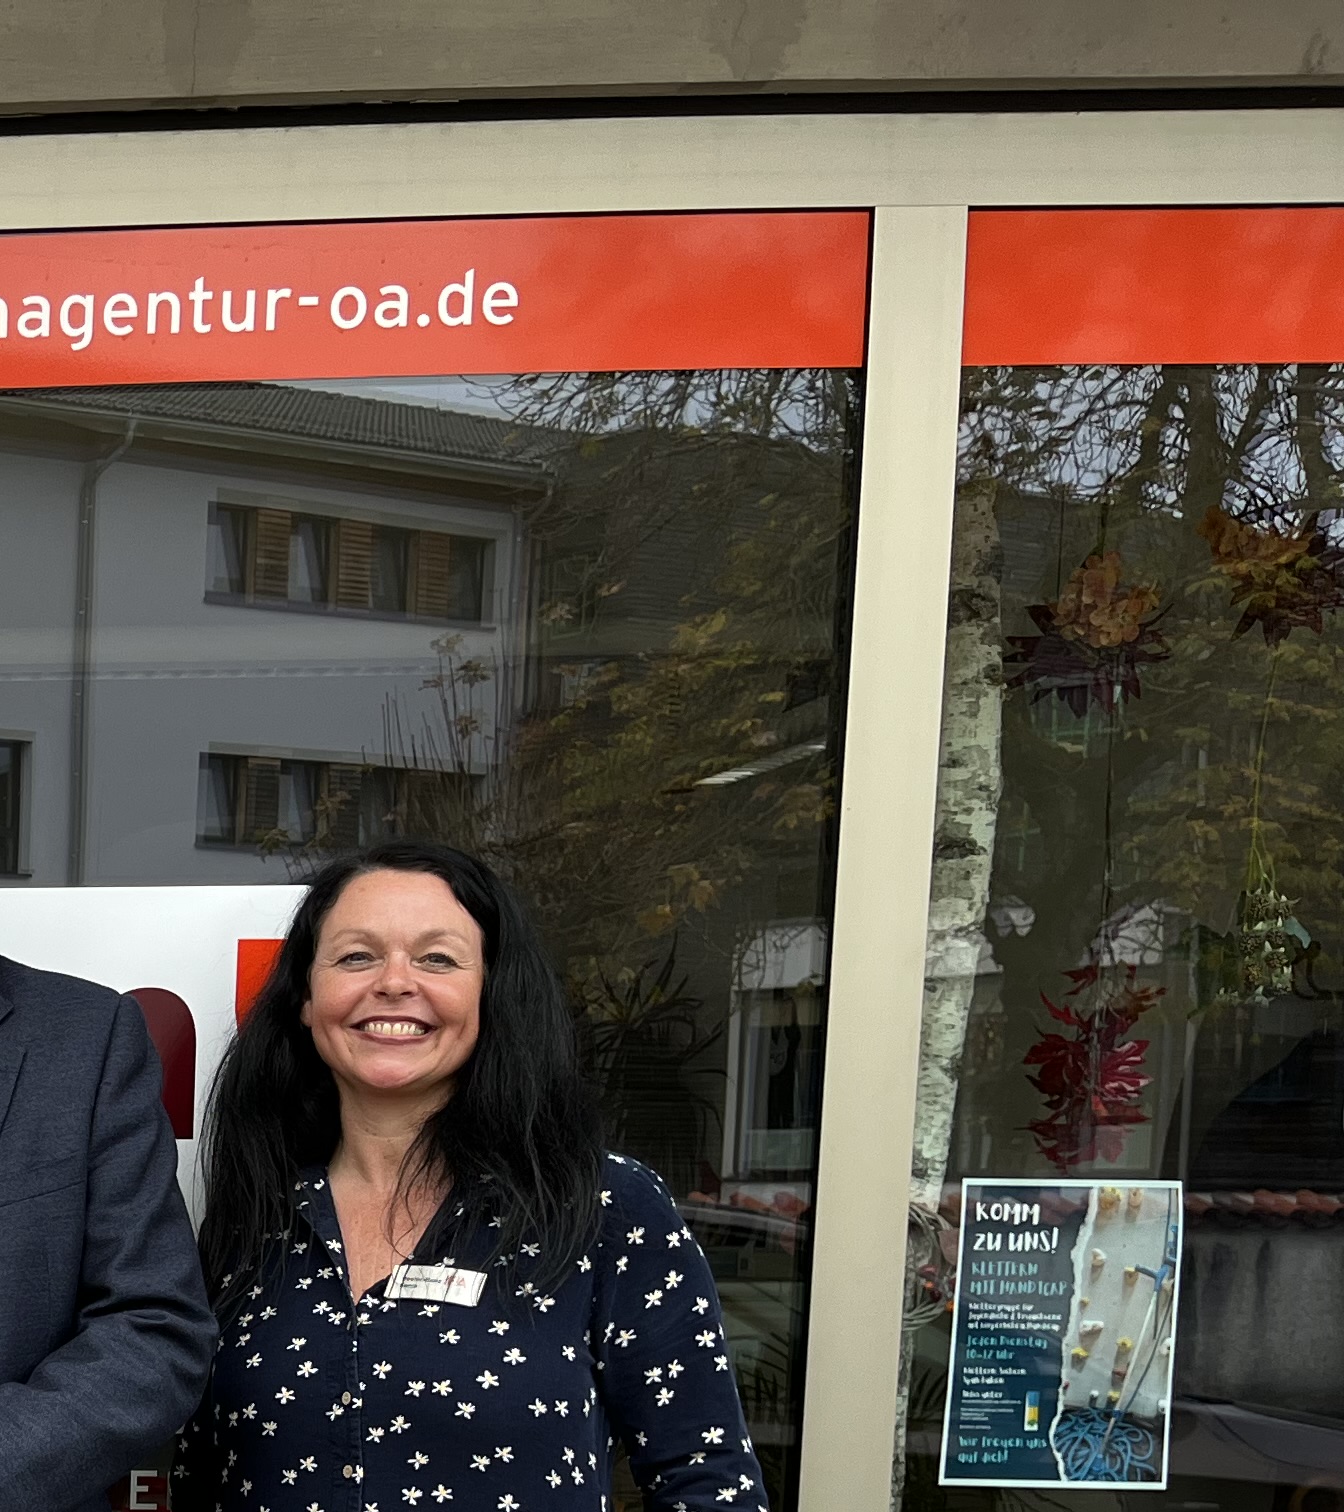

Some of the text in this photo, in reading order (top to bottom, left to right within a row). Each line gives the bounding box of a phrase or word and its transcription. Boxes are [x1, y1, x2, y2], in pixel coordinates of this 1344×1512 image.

[975, 1201, 1041, 1226] KOMM
[972, 1226, 1059, 1254] ZU UNS!
[971, 1260, 1039, 1277] KLETTERN
[970, 1279, 1067, 1297] MIT HANDICAP
[129, 1469, 158, 1511] E
